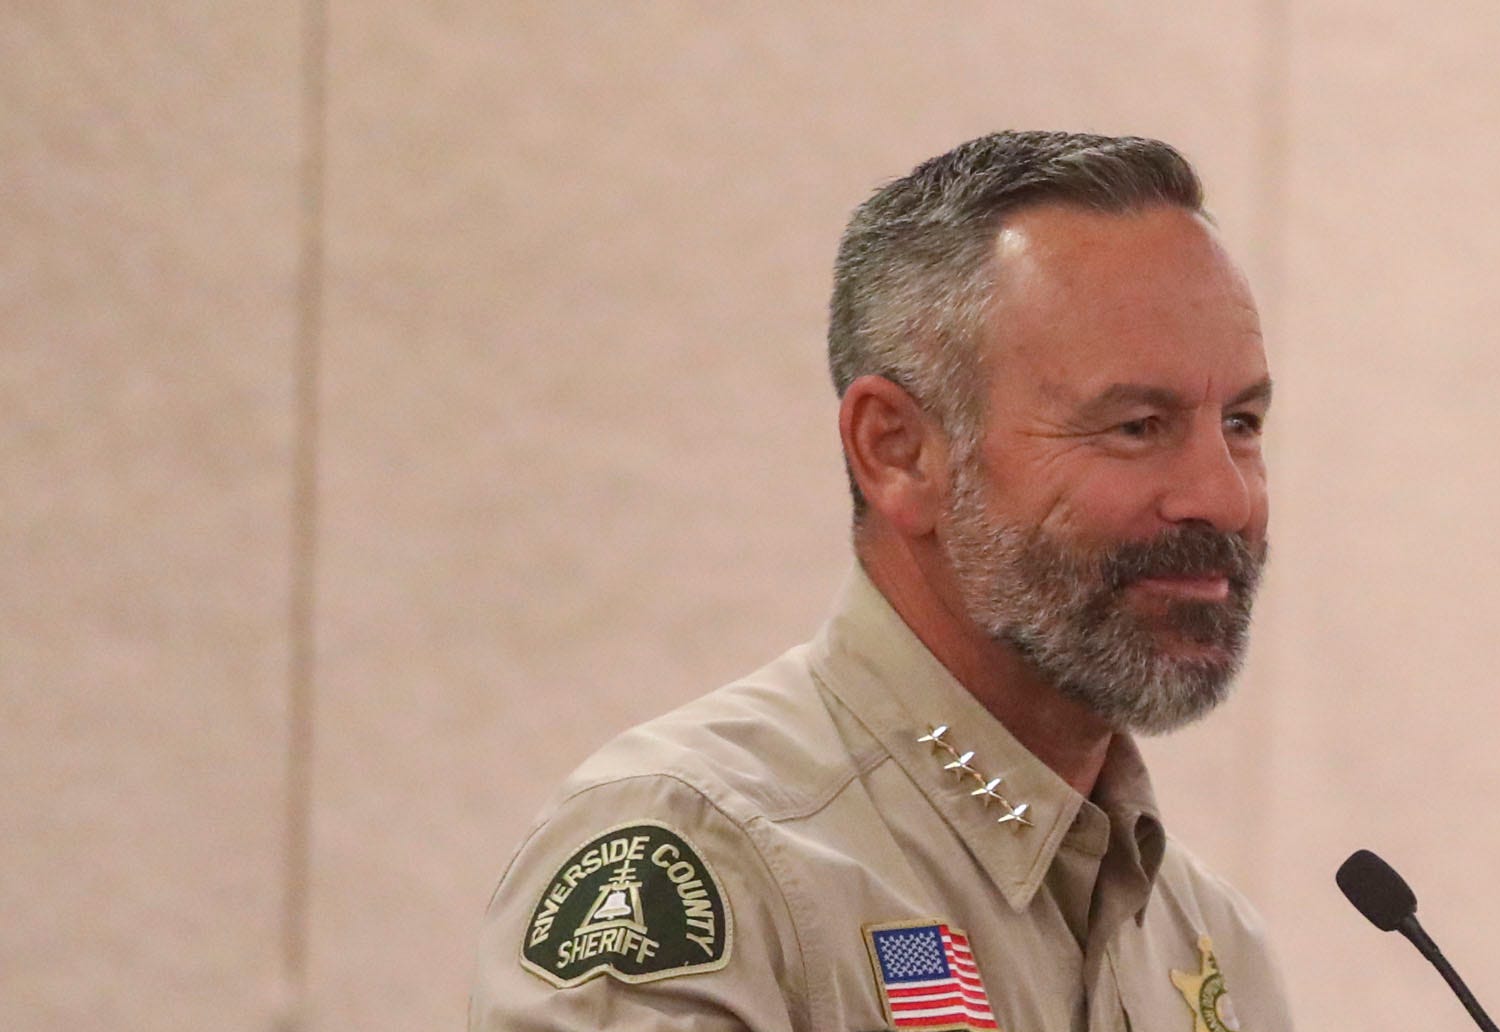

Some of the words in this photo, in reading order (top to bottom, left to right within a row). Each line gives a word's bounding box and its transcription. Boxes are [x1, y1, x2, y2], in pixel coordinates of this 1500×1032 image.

[529, 836, 650, 948] RIVERSIDE
[651, 843, 715, 957] COUNTY
[556, 927, 660, 969] SHERIFF
